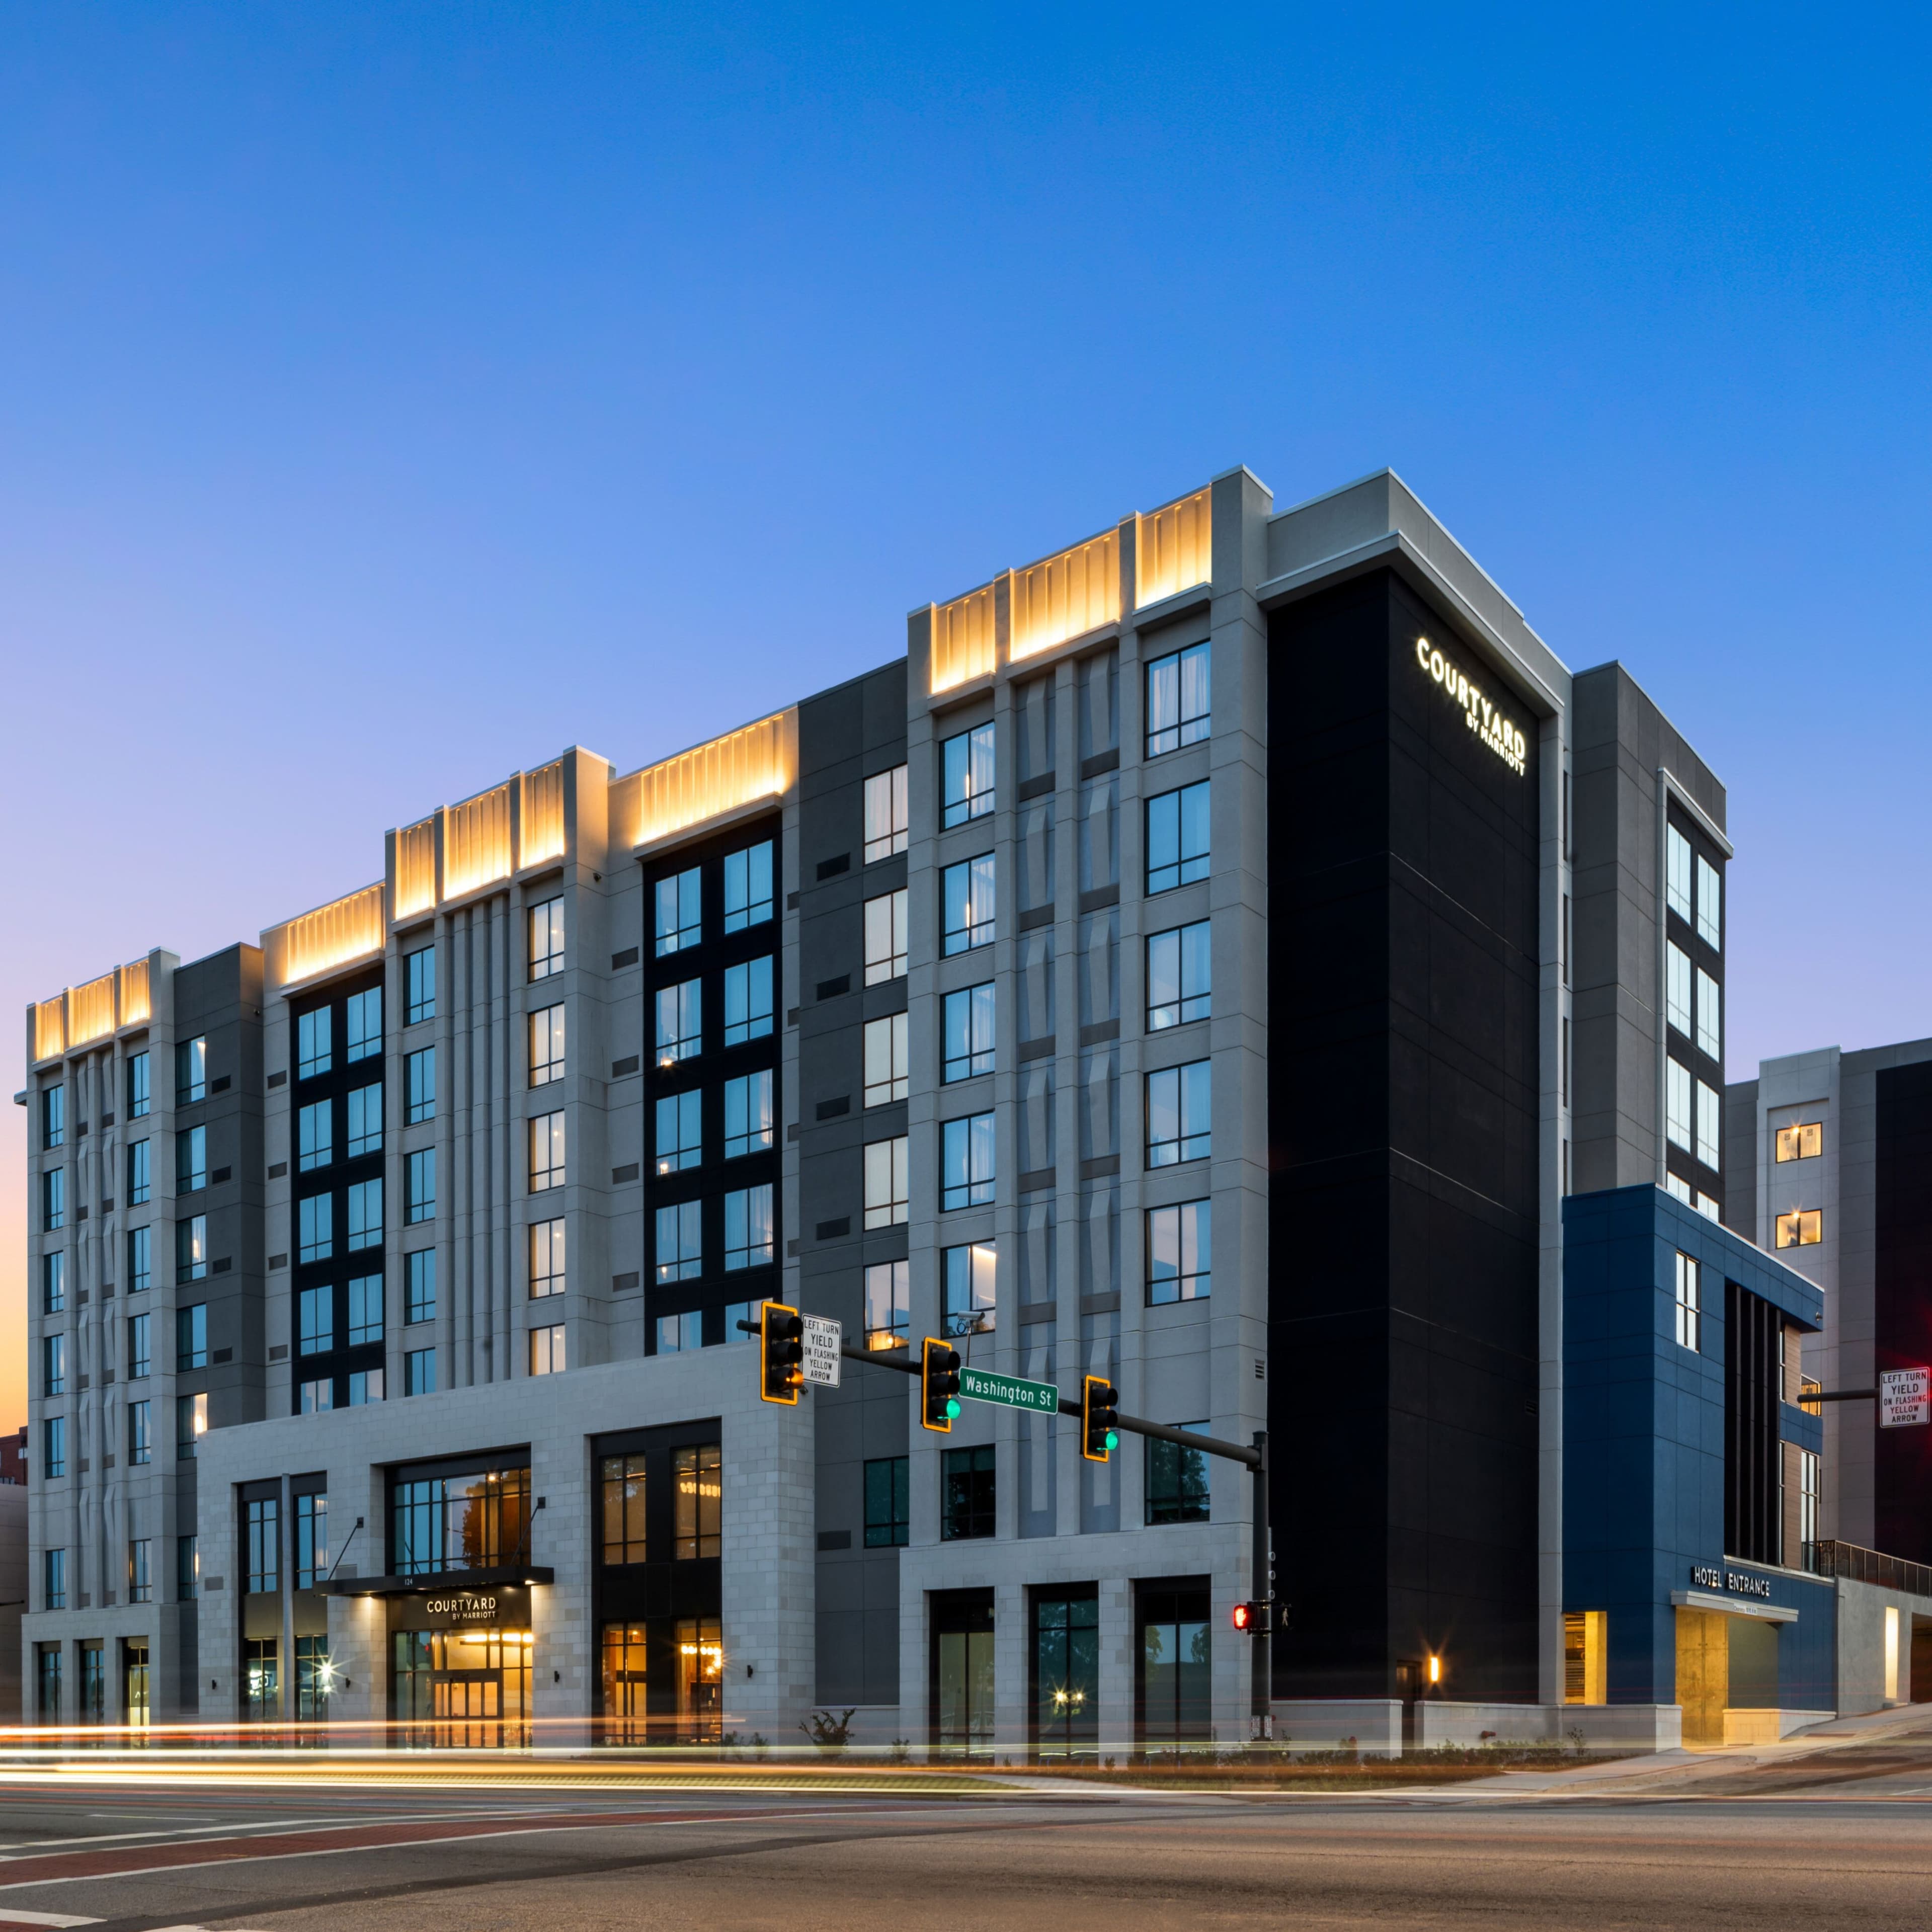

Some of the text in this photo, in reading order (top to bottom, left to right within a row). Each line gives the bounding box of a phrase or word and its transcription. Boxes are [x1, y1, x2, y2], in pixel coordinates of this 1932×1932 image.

[1417, 637, 1525, 760] COURTYARD
[1467, 712, 1524, 776] BY MARRIOTT
[804, 1319, 839, 1335] LEFT TURN
[811, 1333, 833, 1348] YIELD
[804, 1346, 838, 1361] ON FLASHING
[810, 1358, 833, 1371] YELLOW
[810, 1371, 831, 1381] ARROW
[1883, 1372, 1926, 1384] LEFT TURN
[966, 1376, 1051, 1406] Washington St
[1891, 1384, 1919, 1395] YIELD
[1896, 1395, 1926, 1404] FLASHING
[1890, 1405, 1919, 1414] YELLOW
[1892, 1414, 1917, 1423] ARROW
[1695, 1566, 1770, 1597] HOTEL ENTRANCE
[427, 1597, 496, 1613] COURTYARD
[463, 1611, 496, 1620] MARRIOTT
